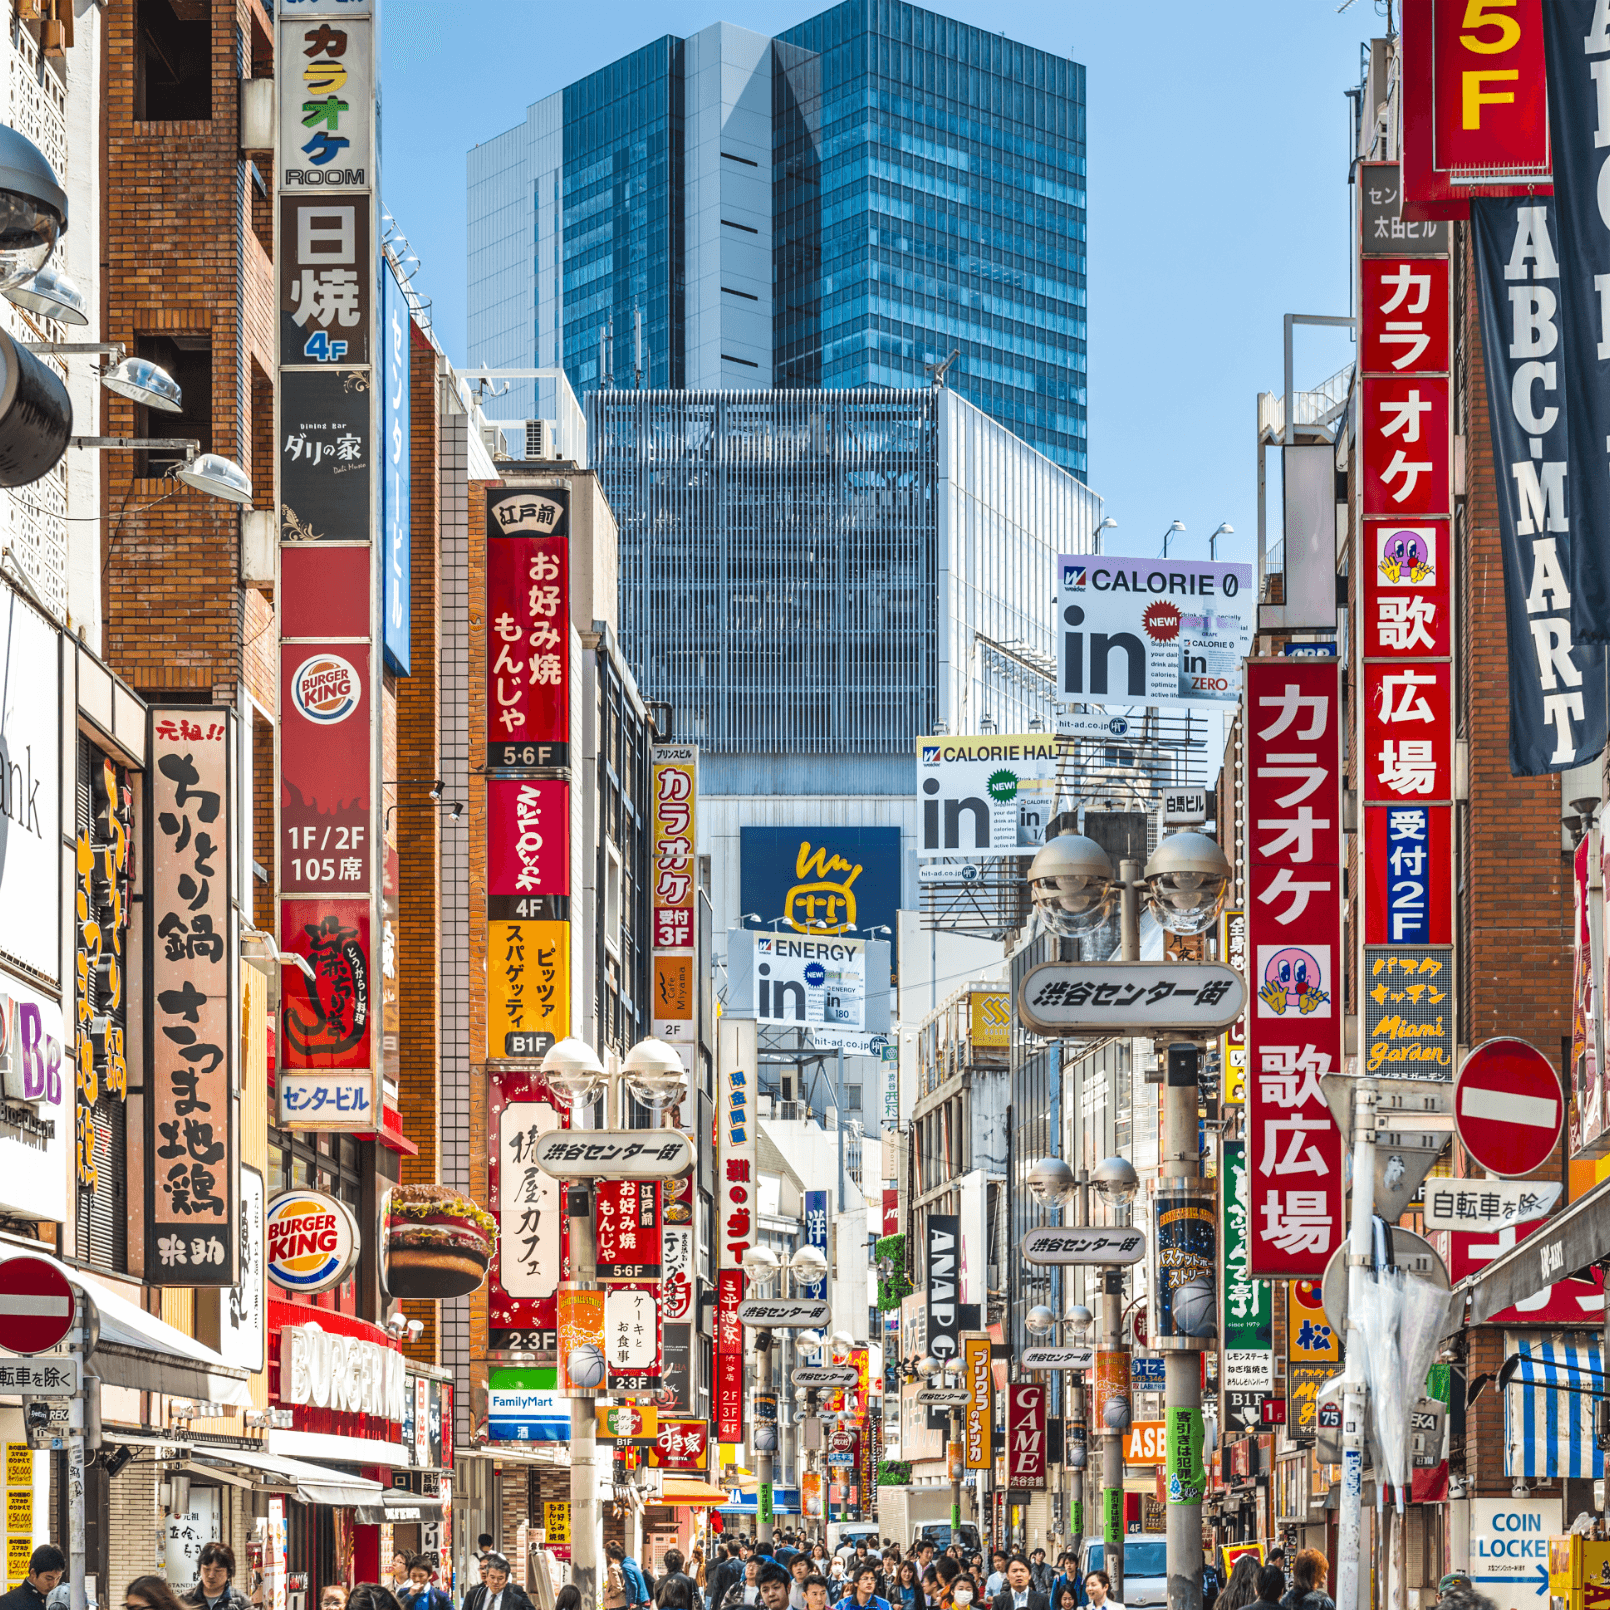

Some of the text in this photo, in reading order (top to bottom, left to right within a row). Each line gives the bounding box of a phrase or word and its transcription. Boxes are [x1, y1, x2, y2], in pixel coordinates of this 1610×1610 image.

[301, 24, 349, 165] カラオケ
[285, 169, 365, 185] ROOM
[291, 206, 361, 328] 日焼
[305, 330, 347, 361] 4F
[1379, 264, 1433, 503] カラオケ
[284, 433, 362, 466] ダリの家
[1504, 206, 1585, 765] ABC-MART
[499, 503, 556, 526] 江戸前
[1092, 569, 1215, 596] CALORIE
[529, 552, 562, 685] お好み焼
[1149, 616, 1178, 627] NEW!
[1064, 605, 1146, 697] in
[1192, 640, 1228, 649] CALORIE
[493, 612, 526, 733] もんじゃ
[1184, 649, 1207, 674] in
[302, 668, 348, 691] BURGER
[1191, 677, 1228, 691] ZERO
[304, 680, 351, 709] KING
[1377, 595, 1437, 796] 歌広場
[1059, 721, 1109, 731] hit-ad.co.jp
[656, 750, 692, 759] プリンスビル
[943, 746, 1020, 762] CALORIE
[992, 782, 1016, 791] NEW!
[923, 777, 990, 849] in
[1166, 795, 1204, 813] 白馬ビル
[1257, 684, 1331, 926] カラオケ
[1021, 807, 1040, 826] in
[657, 768, 692, 905] カラオケ
[157, 753, 224, 963] ちりとり鍋
[291, 857, 362, 881] 105席
[921, 869, 962, 877] hit-ad.co.jp
[1390, 810, 1427, 940] 受付2F
[516, 899, 543, 918] 4F
[659, 910, 689, 925] 受付
[659, 927, 689, 945] 3F
[776, 940, 857, 962] ENERGY
[505, 925, 525, 1028] スパゲッティ
[1372, 957, 1443, 978] パスタ
[346, 947, 367, 1025] とうがらし料理
[536, 948, 556, 1018] ピッツァ
[677, 966, 687, 1010] Miyama
[758, 963, 806, 1021] in
[1033, 980, 1233, 1006] 渋谷センター街
[1370, 983, 1447, 1005] キッチン
[827, 992, 840, 1007] in
[835, 1010, 849, 1018] 180
[666, 1025, 681, 1035] 2F
[1372, 1015, 1445, 1039] Miami
[512, 1036, 547, 1052] B1F
[814, 1037, 870, 1051] hit-ad.co.jp
[283, 1086, 369, 1111] センタービル
[543, 1143, 683, 1162] 渋谷センター街
[1259, 1044, 1333, 1255] 歌広場
[619, 1181, 637, 1250] お好み焼
[641, 1185, 654, 1227] 江戸前
[1434, 1191, 1549, 1221] 自転車を除く
[268, 1214, 337, 1241] BURGER
[599, 1199, 616, 1262] もんじゃ
[269, 1230, 338, 1265] KING
[1030, 1237, 1140, 1252] 渋谷センター街
[931, 1228, 955, 1326] ANAP
[634, 1295, 645, 1348] ケーキと
[743, 1307, 826, 1318] 渋谷センター街
[617, 1321, 630, 1363] お食事
[1027, 1353, 1092, 1361] 渋谷センター街
[1227, 1353, 1269, 1361] レモンステーキ
[797, 1373, 854, 1381] 渋谷センター街
[1227, 1365, 1268, 1373] ねぎ塩焼き
[493, 1396, 553, 1410] FamilyMart
[723, 1391, 737, 1401] 2F
[968, 1348, 989, 1462] プリクラのメッカ
[723, 1407, 737, 1417] 3F
[1265, 1403, 1283, 1421] 1F
[1322, 1411, 1339, 1426] 75
[517, 1426, 529, 1439] 酒
[657, 1424, 700, 1456] すき家
[723, 1424, 737, 1433] 4F
[1013, 1387, 1042, 1473] GAME
[183, 1512, 199, 1521] 元祖
[1129, 1523, 1141, 1533] 4F
[1492, 1513, 1541, 1532] COIN
[1480, 1539, 1550, 1558] LOCKE
